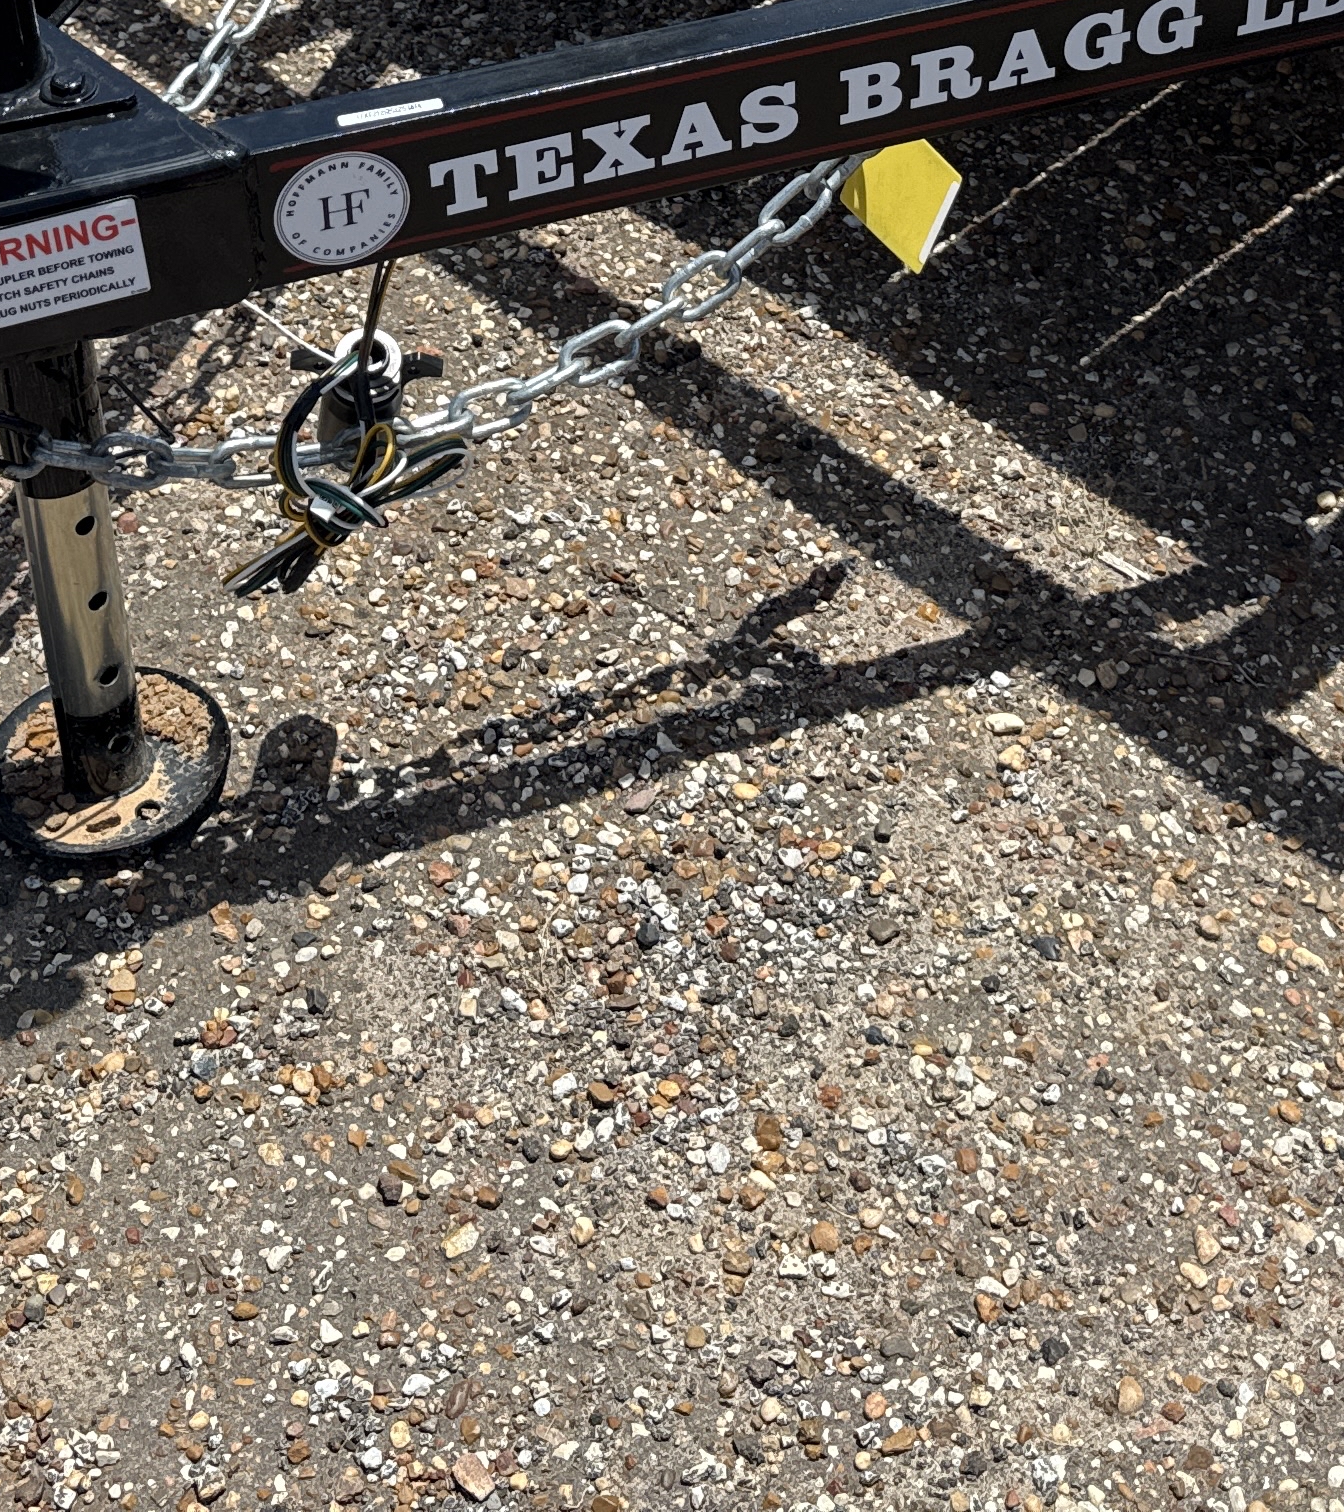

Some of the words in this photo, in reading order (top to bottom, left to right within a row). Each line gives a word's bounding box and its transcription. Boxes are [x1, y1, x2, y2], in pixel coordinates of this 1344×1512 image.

[429, 80, 800, 218] TEXAS
[285, 161, 350, 217] HOFFMANN
[358, 161, 399, 196] FAMILY
[317, 188, 370, 232] HF
[291, 231, 308, 246] OF
[312, 213, 396, 257] COMPANIES
[23, 276, 70, 296] SAFETY
[70, 265, 116, 285] CHAINS
[37, 258, 86, 277] BEFORE
[86, 244, 135, 265] TOWING
[19, 297, 52, 315] NUTS
[53, 276, 136, 306] PERIODICALLY
